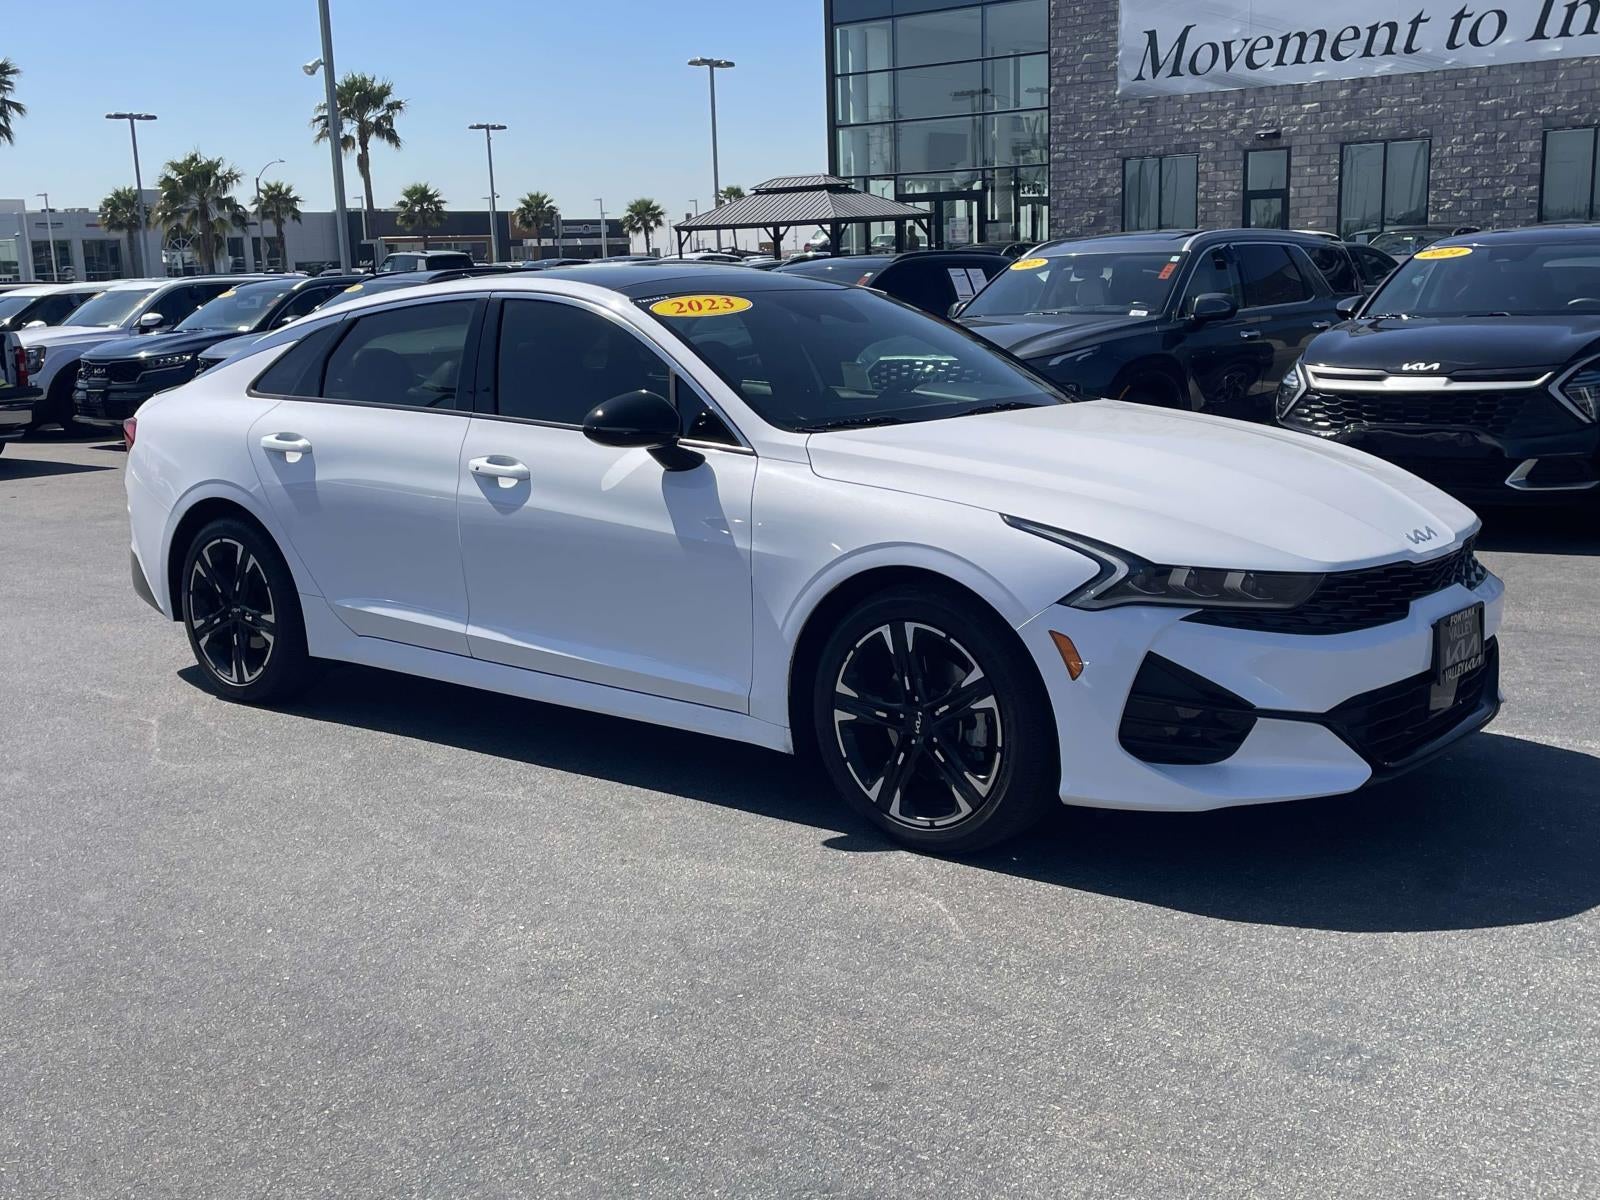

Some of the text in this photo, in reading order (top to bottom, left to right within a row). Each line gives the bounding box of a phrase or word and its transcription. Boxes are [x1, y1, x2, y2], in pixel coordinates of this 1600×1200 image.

[1132, 15, 1432, 82] Movement
[1445, 4, 1508, 51] to
[671, 297, 734, 314] 2023
[1449, 619, 1473, 641] VALLEY
[1445, 662, 1465, 682] VALLEY
